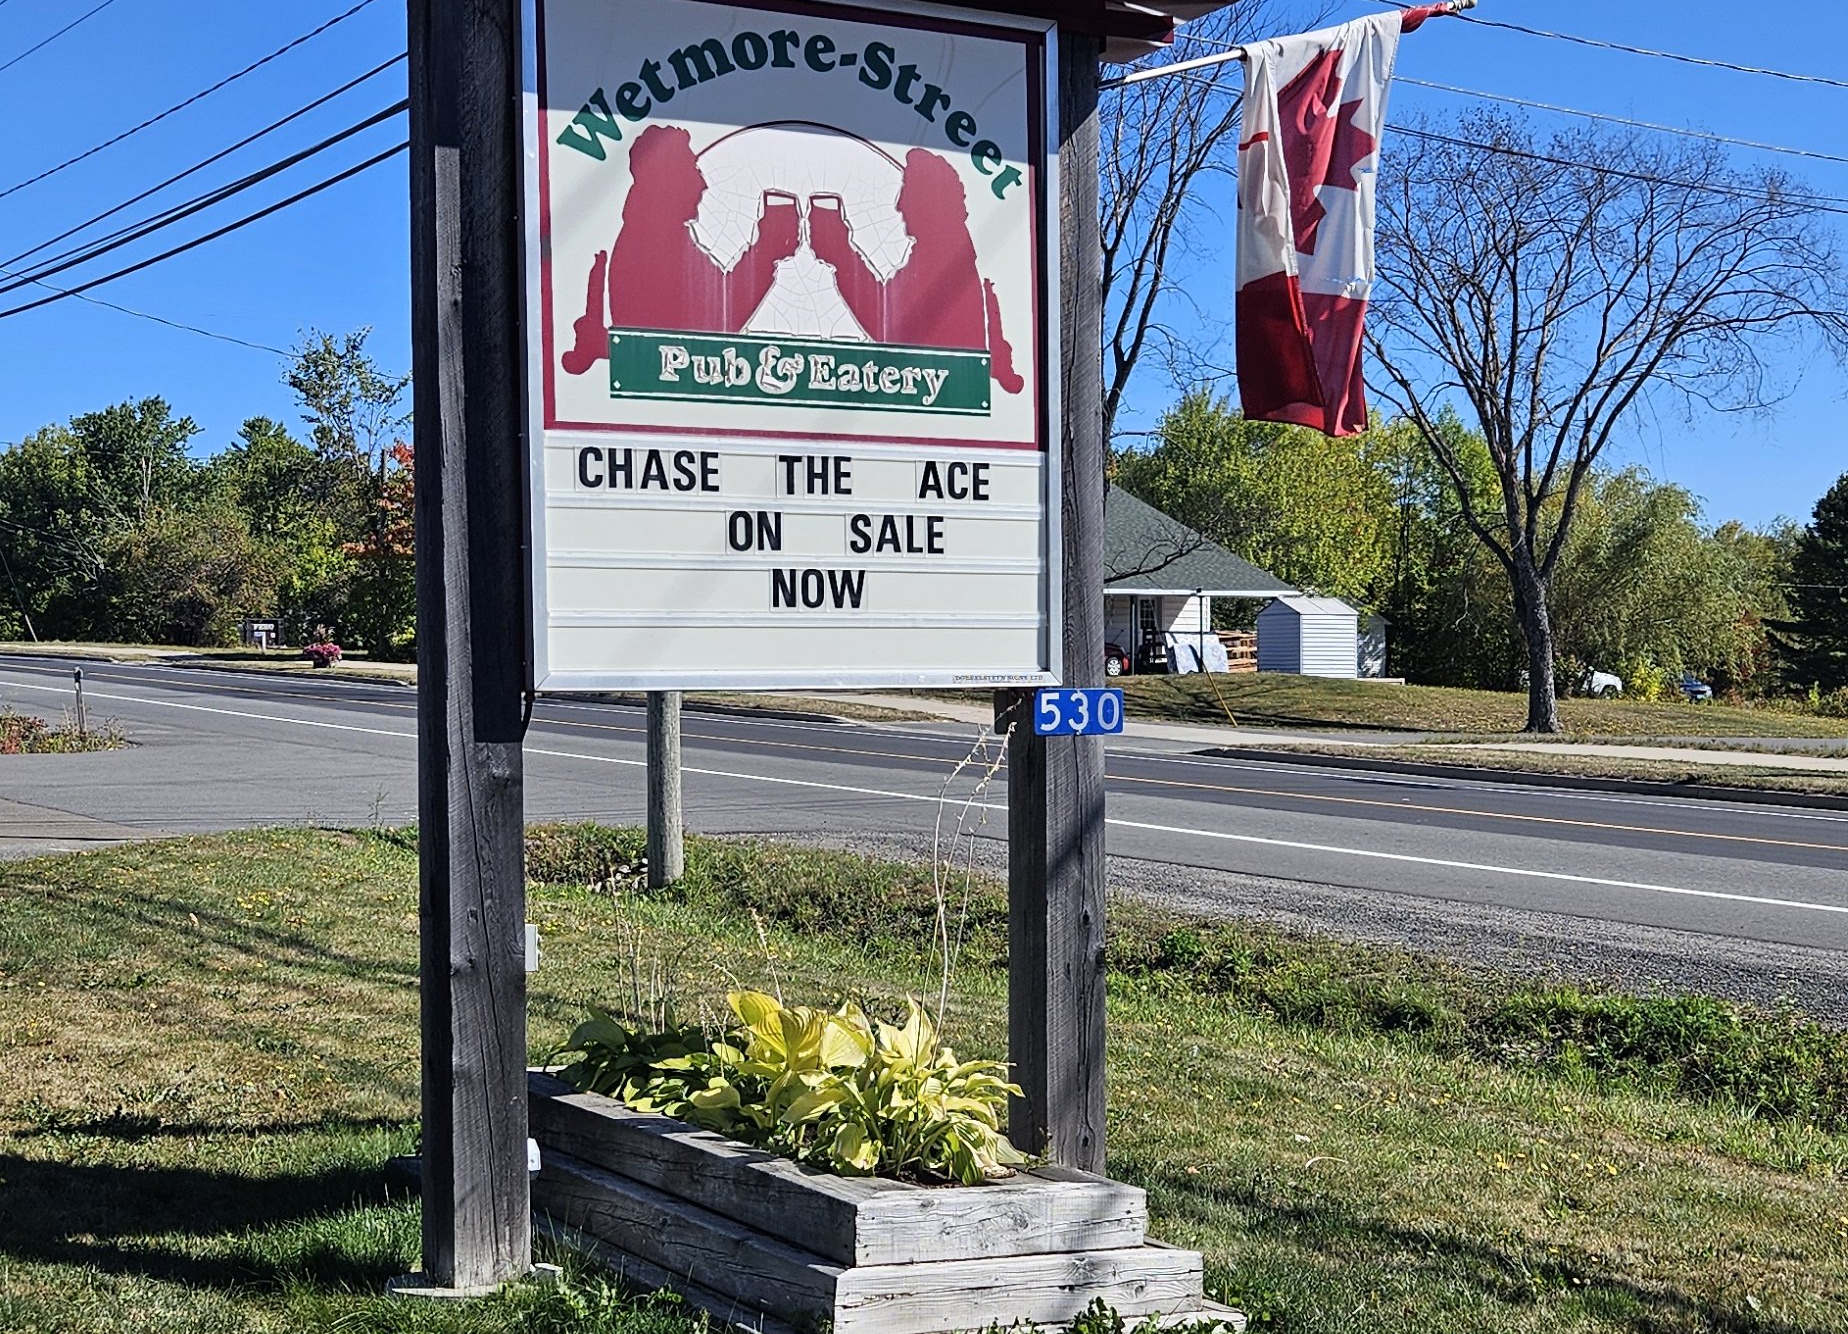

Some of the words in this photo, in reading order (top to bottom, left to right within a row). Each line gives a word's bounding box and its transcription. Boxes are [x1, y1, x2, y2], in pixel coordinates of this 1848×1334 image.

[556, 29, 1023, 201] Wetmore-Street
[578, 446, 720, 493] CHASE
[778, 455, 852, 496] THE
[918, 461, 990, 501] ACE
[728, 510, 782, 552] ON
[849, 514, 945, 555] SALE
[771, 568, 866, 609] NOW
[1040, 692, 1120, 732] 530
